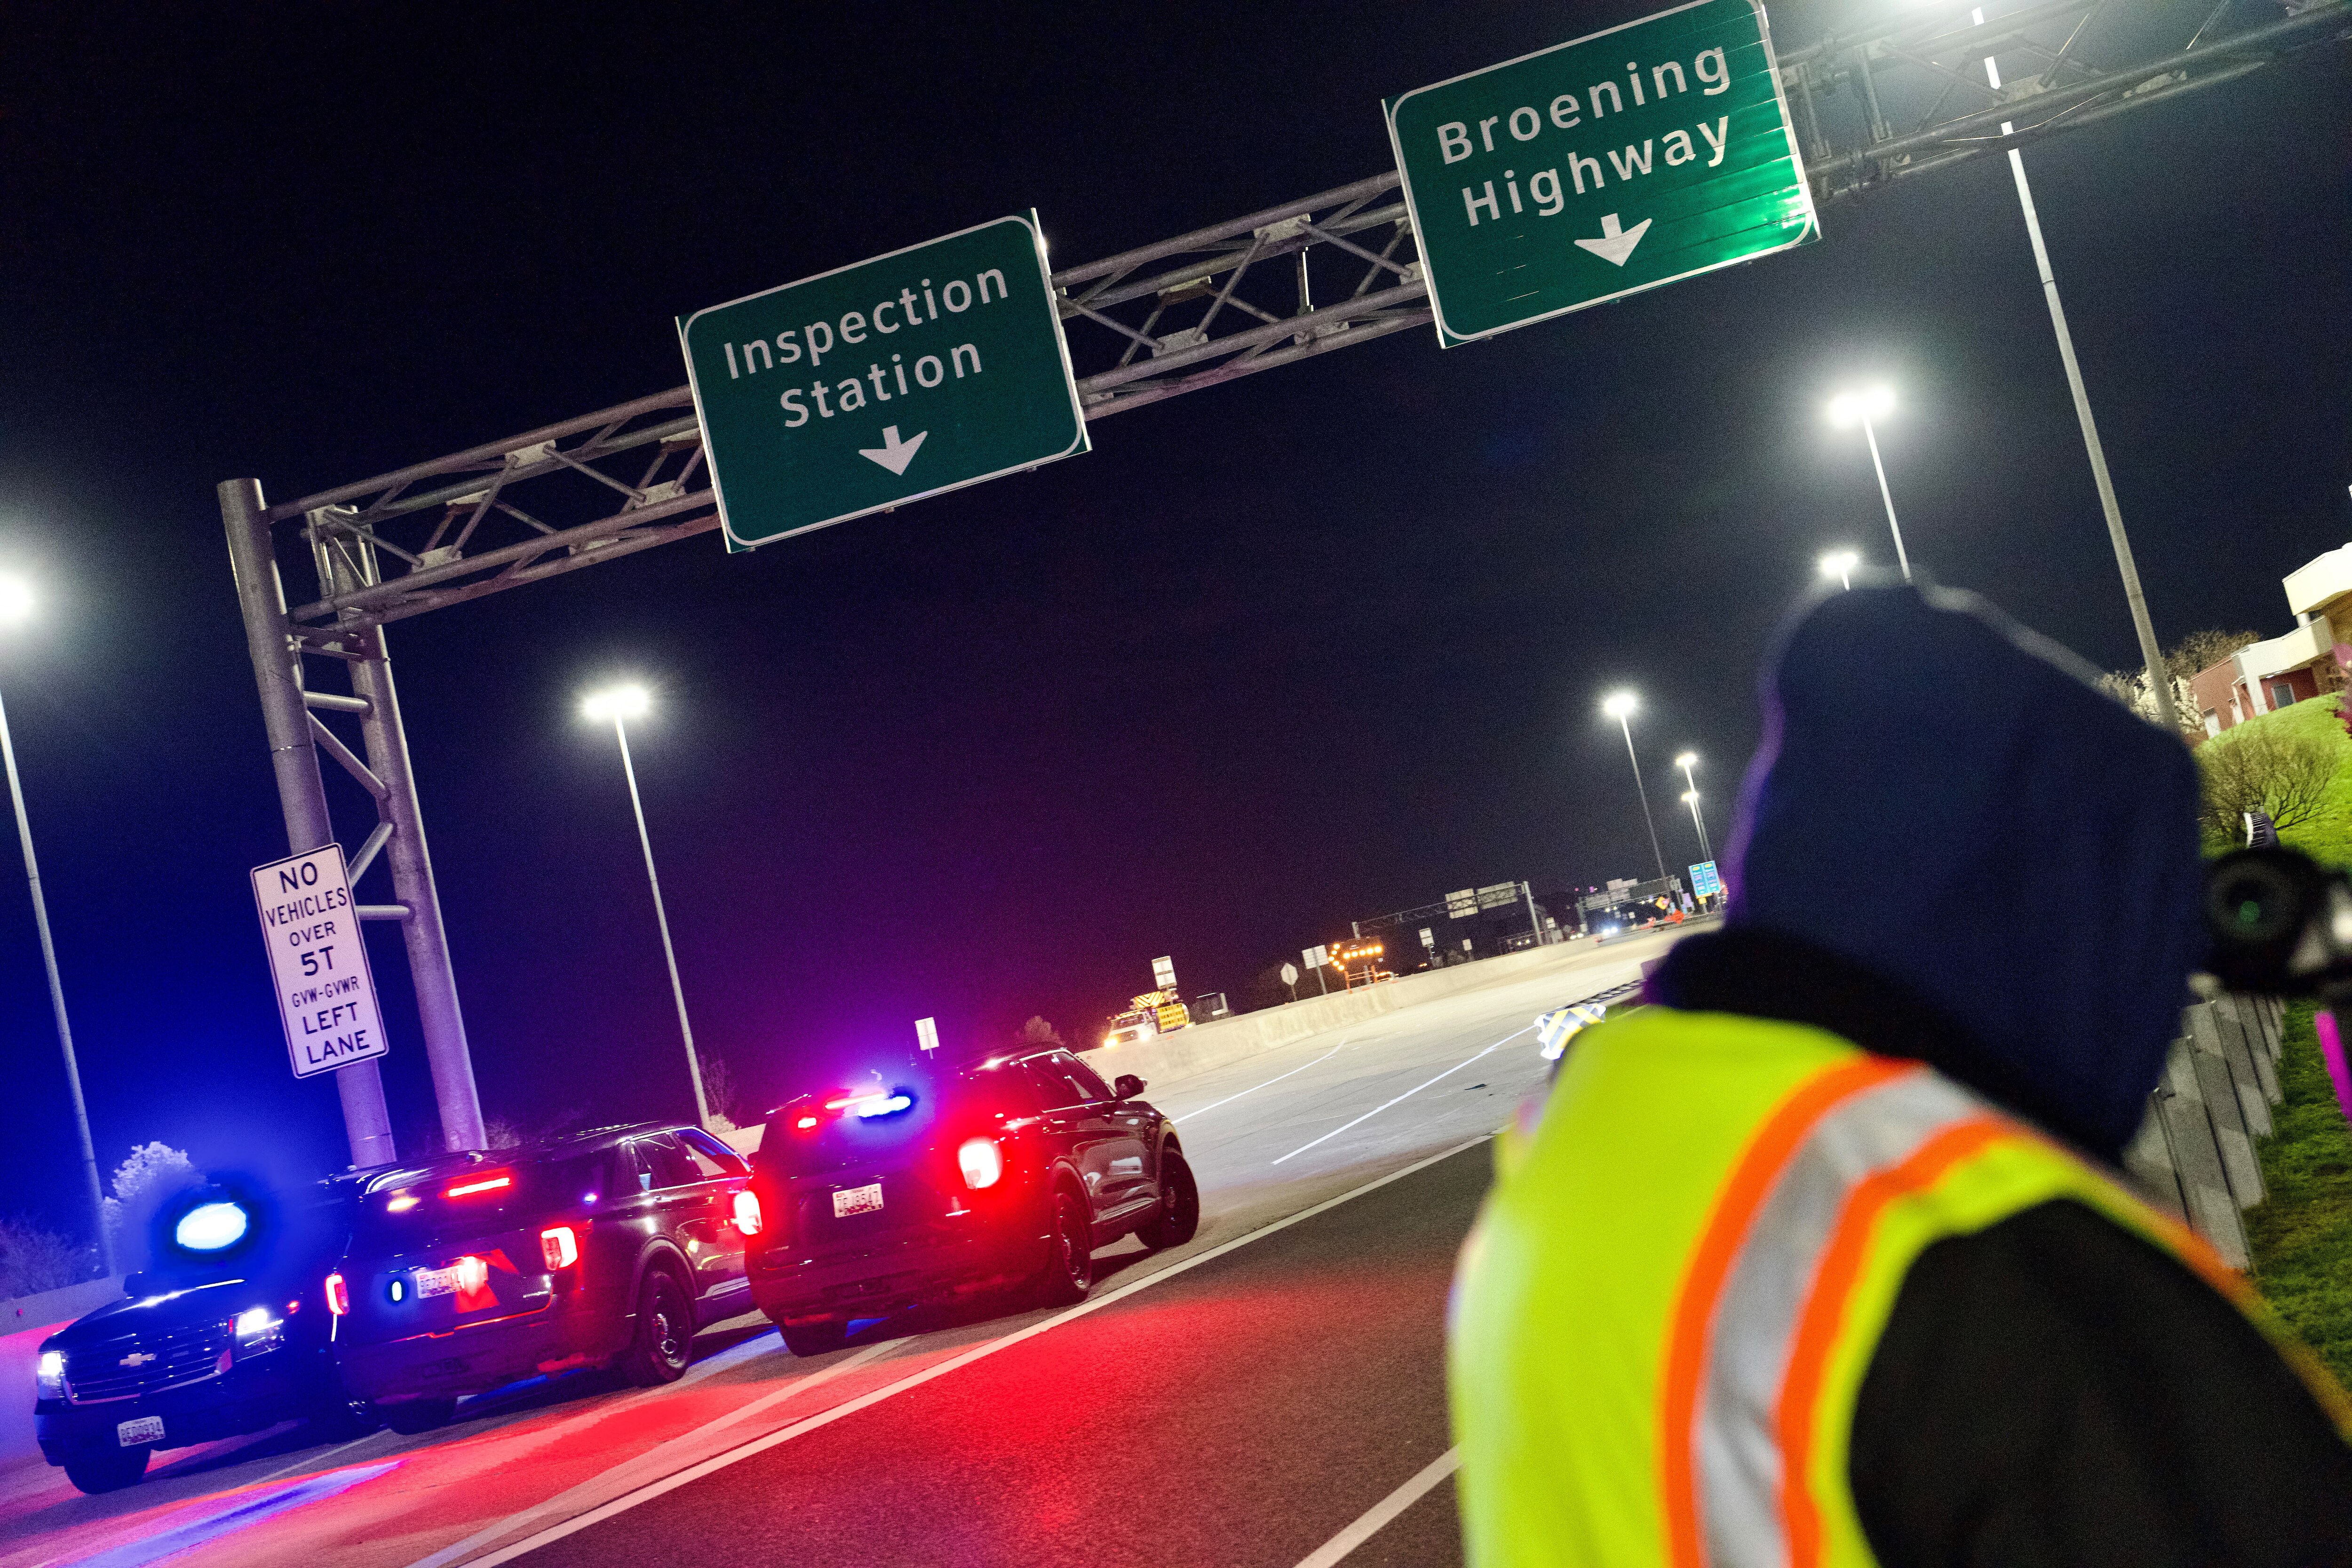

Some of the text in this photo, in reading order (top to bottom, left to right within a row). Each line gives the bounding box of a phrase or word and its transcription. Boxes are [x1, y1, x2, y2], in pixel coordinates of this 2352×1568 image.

[1437, 47, 1731, 164] Broening
[1462, 116, 1729, 226] Highway
[724, 269, 1008, 379] Inspection
[780, 343, 982, 427] Station
[279, 861, 318, 893] NO
[265, 887, 347, 927] VEHICLES
[289, 921, 336, 947] OVER
[301, 945, 334, 977] 5T
[292, 976, 359, 1008] GVW-GVWR
[302, 1001, 358, 1035] LEFT
[306, 1029, 370, 1065] LANE
